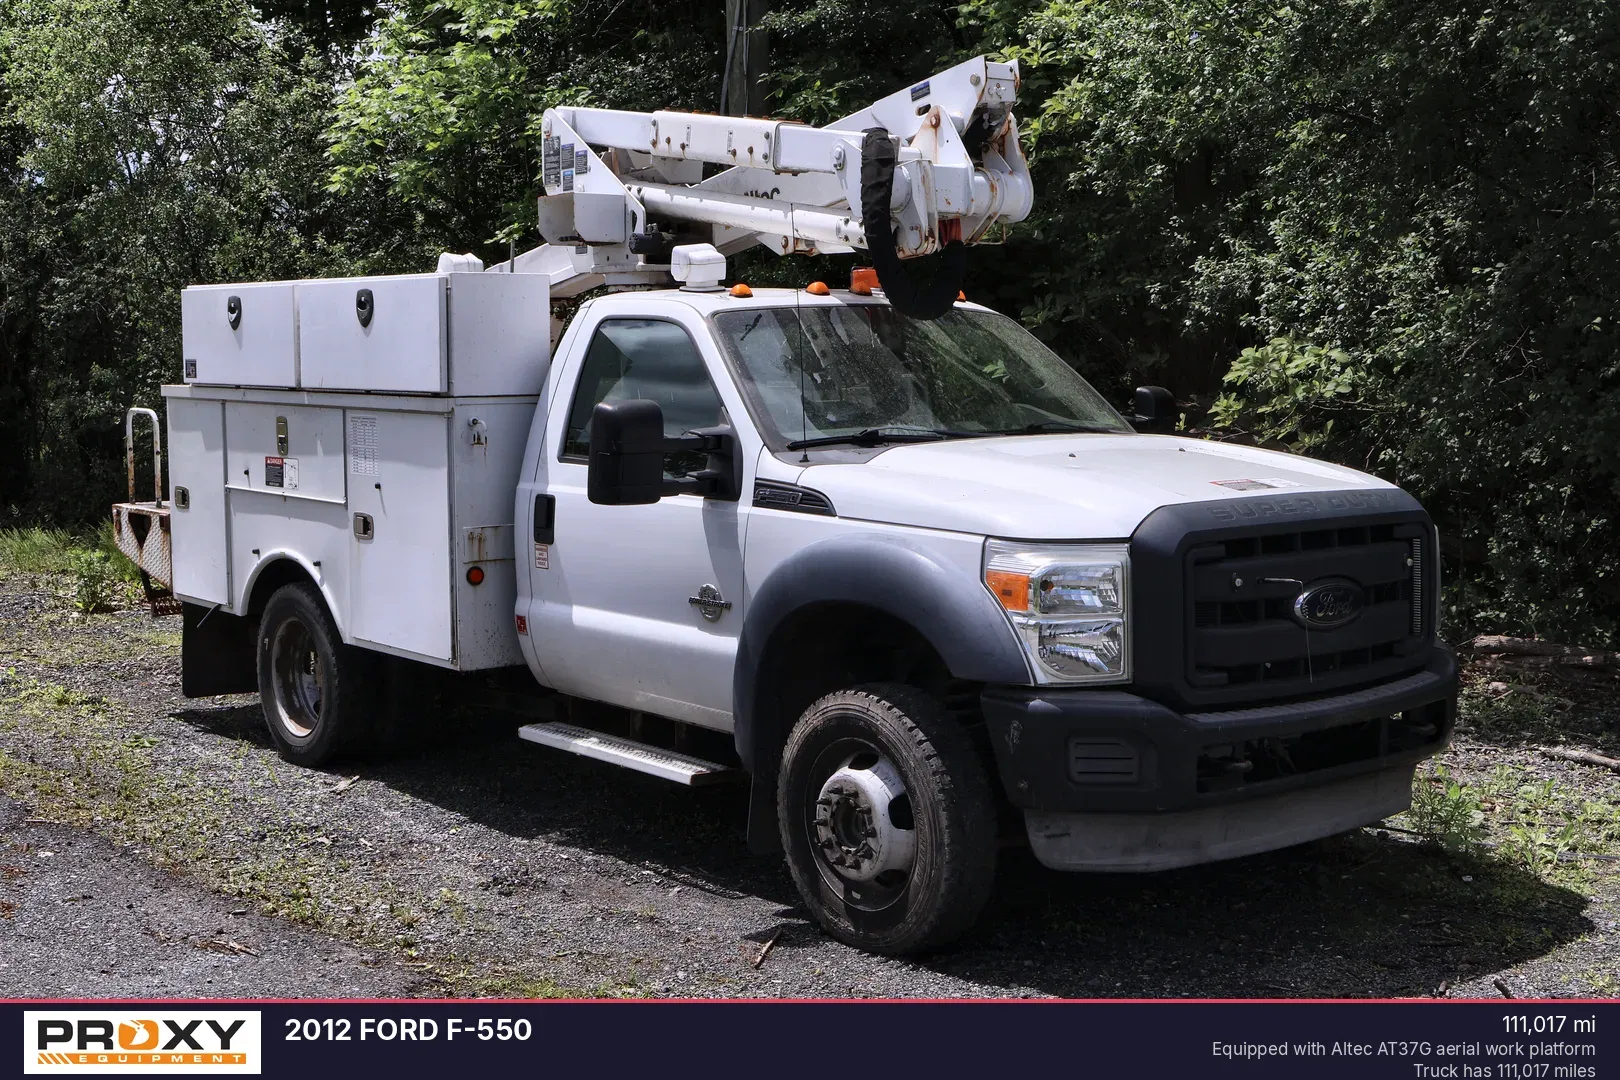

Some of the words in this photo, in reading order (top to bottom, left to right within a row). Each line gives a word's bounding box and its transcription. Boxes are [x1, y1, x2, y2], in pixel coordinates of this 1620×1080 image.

[1209, 498, 1321, 522] SUPER
[1328, 491, 1392, 511] DUTY
[1316, 590, 1354, 618] Ford
